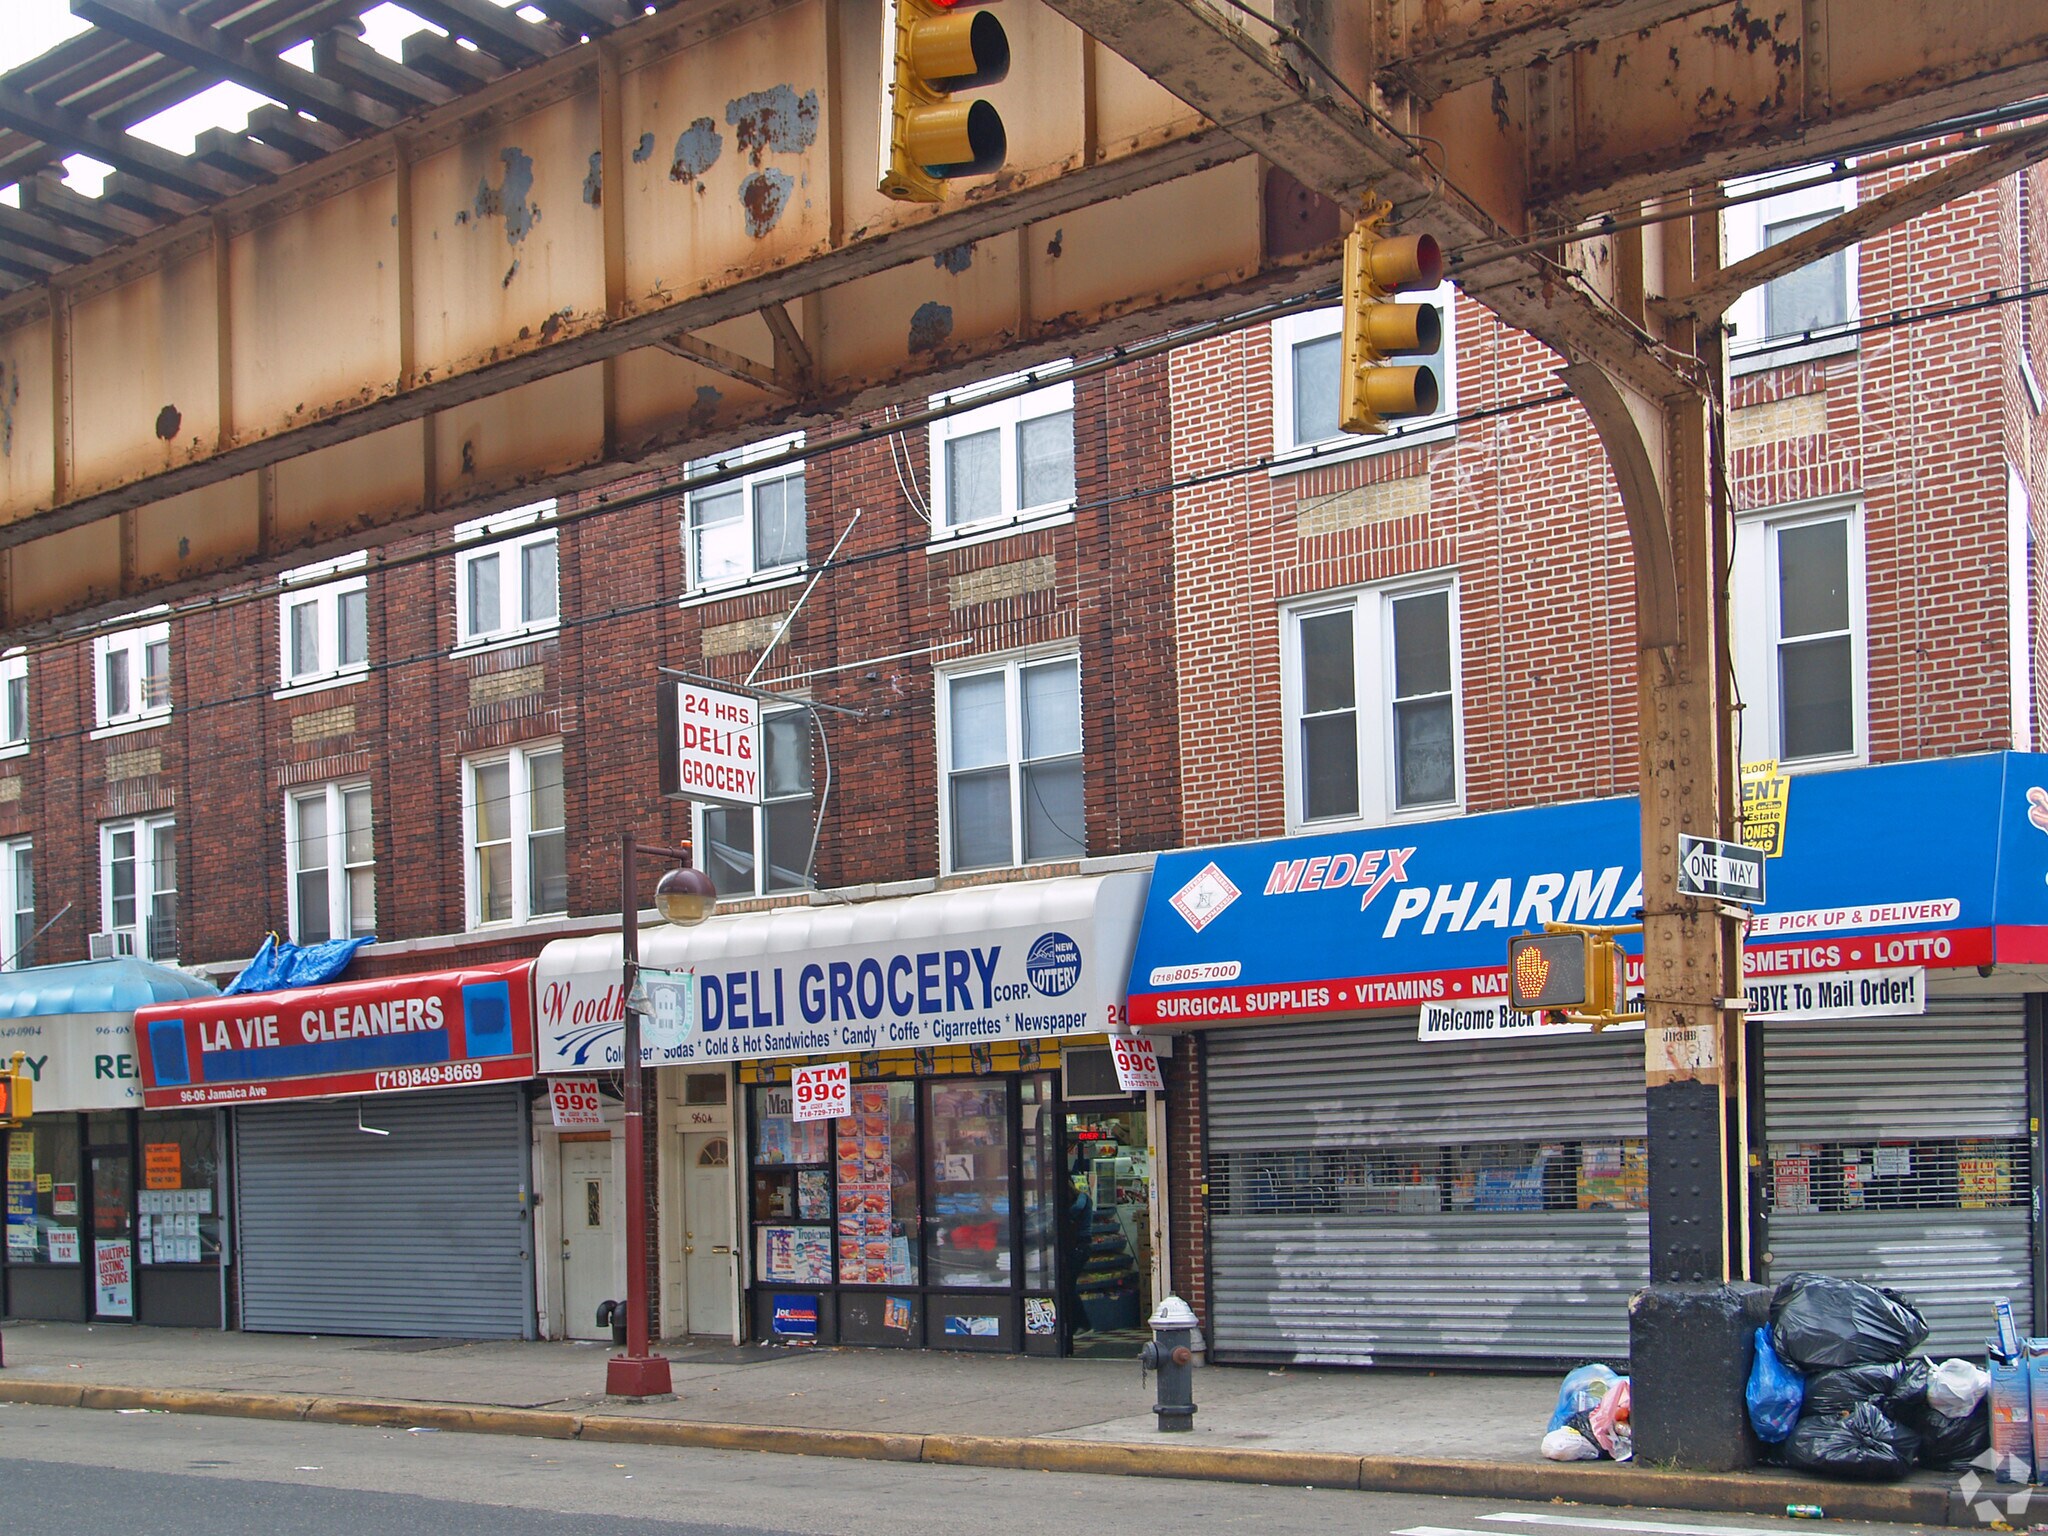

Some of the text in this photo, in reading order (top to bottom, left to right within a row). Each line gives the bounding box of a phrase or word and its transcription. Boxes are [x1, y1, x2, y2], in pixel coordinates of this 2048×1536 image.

[685, 694, 754, 726] 24 HRS.
[683, 723, 752, 759] DELI &
[683, 759, 756, 795] GROCERY
[1742, 779, 1784, 801] ENT
[1263, 846, 1417, 912] MEDEX
[1691, 855, 1754, 885] ONE WAY
[1382, 866, 1643, 938] PHARMA
[1779, 914, 1818, 929] PICK
[1823, 911, 1846, 925] UP
[1852, 910, 1863, 923] &
[1869, 903, 1954, 922] DELIVERY
[1055, 942, 1073, 952] NEW
[1055, 953, 1077, 963] YORK
[1032, 966, 1077, 993] LOTTERY
[1152, 964, 1237, 984] (718)805-7000
[1156, 937, 1951, 1018] SURGICAL SUPPLIES VITAMINS NAT SMETICS LOTTO
[543, 981, 624, 1027] Woodh
[700, 967, 785, 1032] DELI
[799, 945, 1002, 1025] GROCERY
[993, 983, 1031, 1002] CORP.
[1428, 1006, 1496, 1032] Welcome
[1793, 983, 1812, 1010] To
[1818, 979, 1854, 1009] Mail
[1860, 976, 1915, 1007] Order!
[199, 996, 445, 1051] LA VIE CLEANERS
[705, 1037, 729, 1056] Cold
[731, 1036, 740, 1053] &
[743, 1035, 762, 1053] Hot
[764, 1030, 830, 1051] Sandwiches
[841, 1025, 877, 1048] Candy
[889, 1023, 920, 1042] Coffe
[933, 1019, 1001, 1042] Cigarrettes
[1015, 1012, 1087, 1034] Newspaper
[1115, 1039, 1153, 1052] ATM
[1117, 1053, 1156, 1073] 99¢
[375, 1063, 483, 1091] (718)849-8669
[796, 1067, 847, 1085] ATM
[181, 1085, 267, 1102] 96-06 Jamaica Ave
[553, 1082, 597, 1093] ATM
[797, 1083, 846, 1103] 99¢
[555, 1094, 598, 1111] 99¢
[1779, 1166, 1805, 1176] OPEN
[50, 1233, 76, 1244] INCOME
[797, 1228, 830, 1240] Tropicana
[58, 1247, 72, 1258] TAX
[98, 1246, 131, 1262] MULTIPLE
[99, 1259, 125, 1275] LISTING
[101, 1271, 129, 1287] SERVICE
